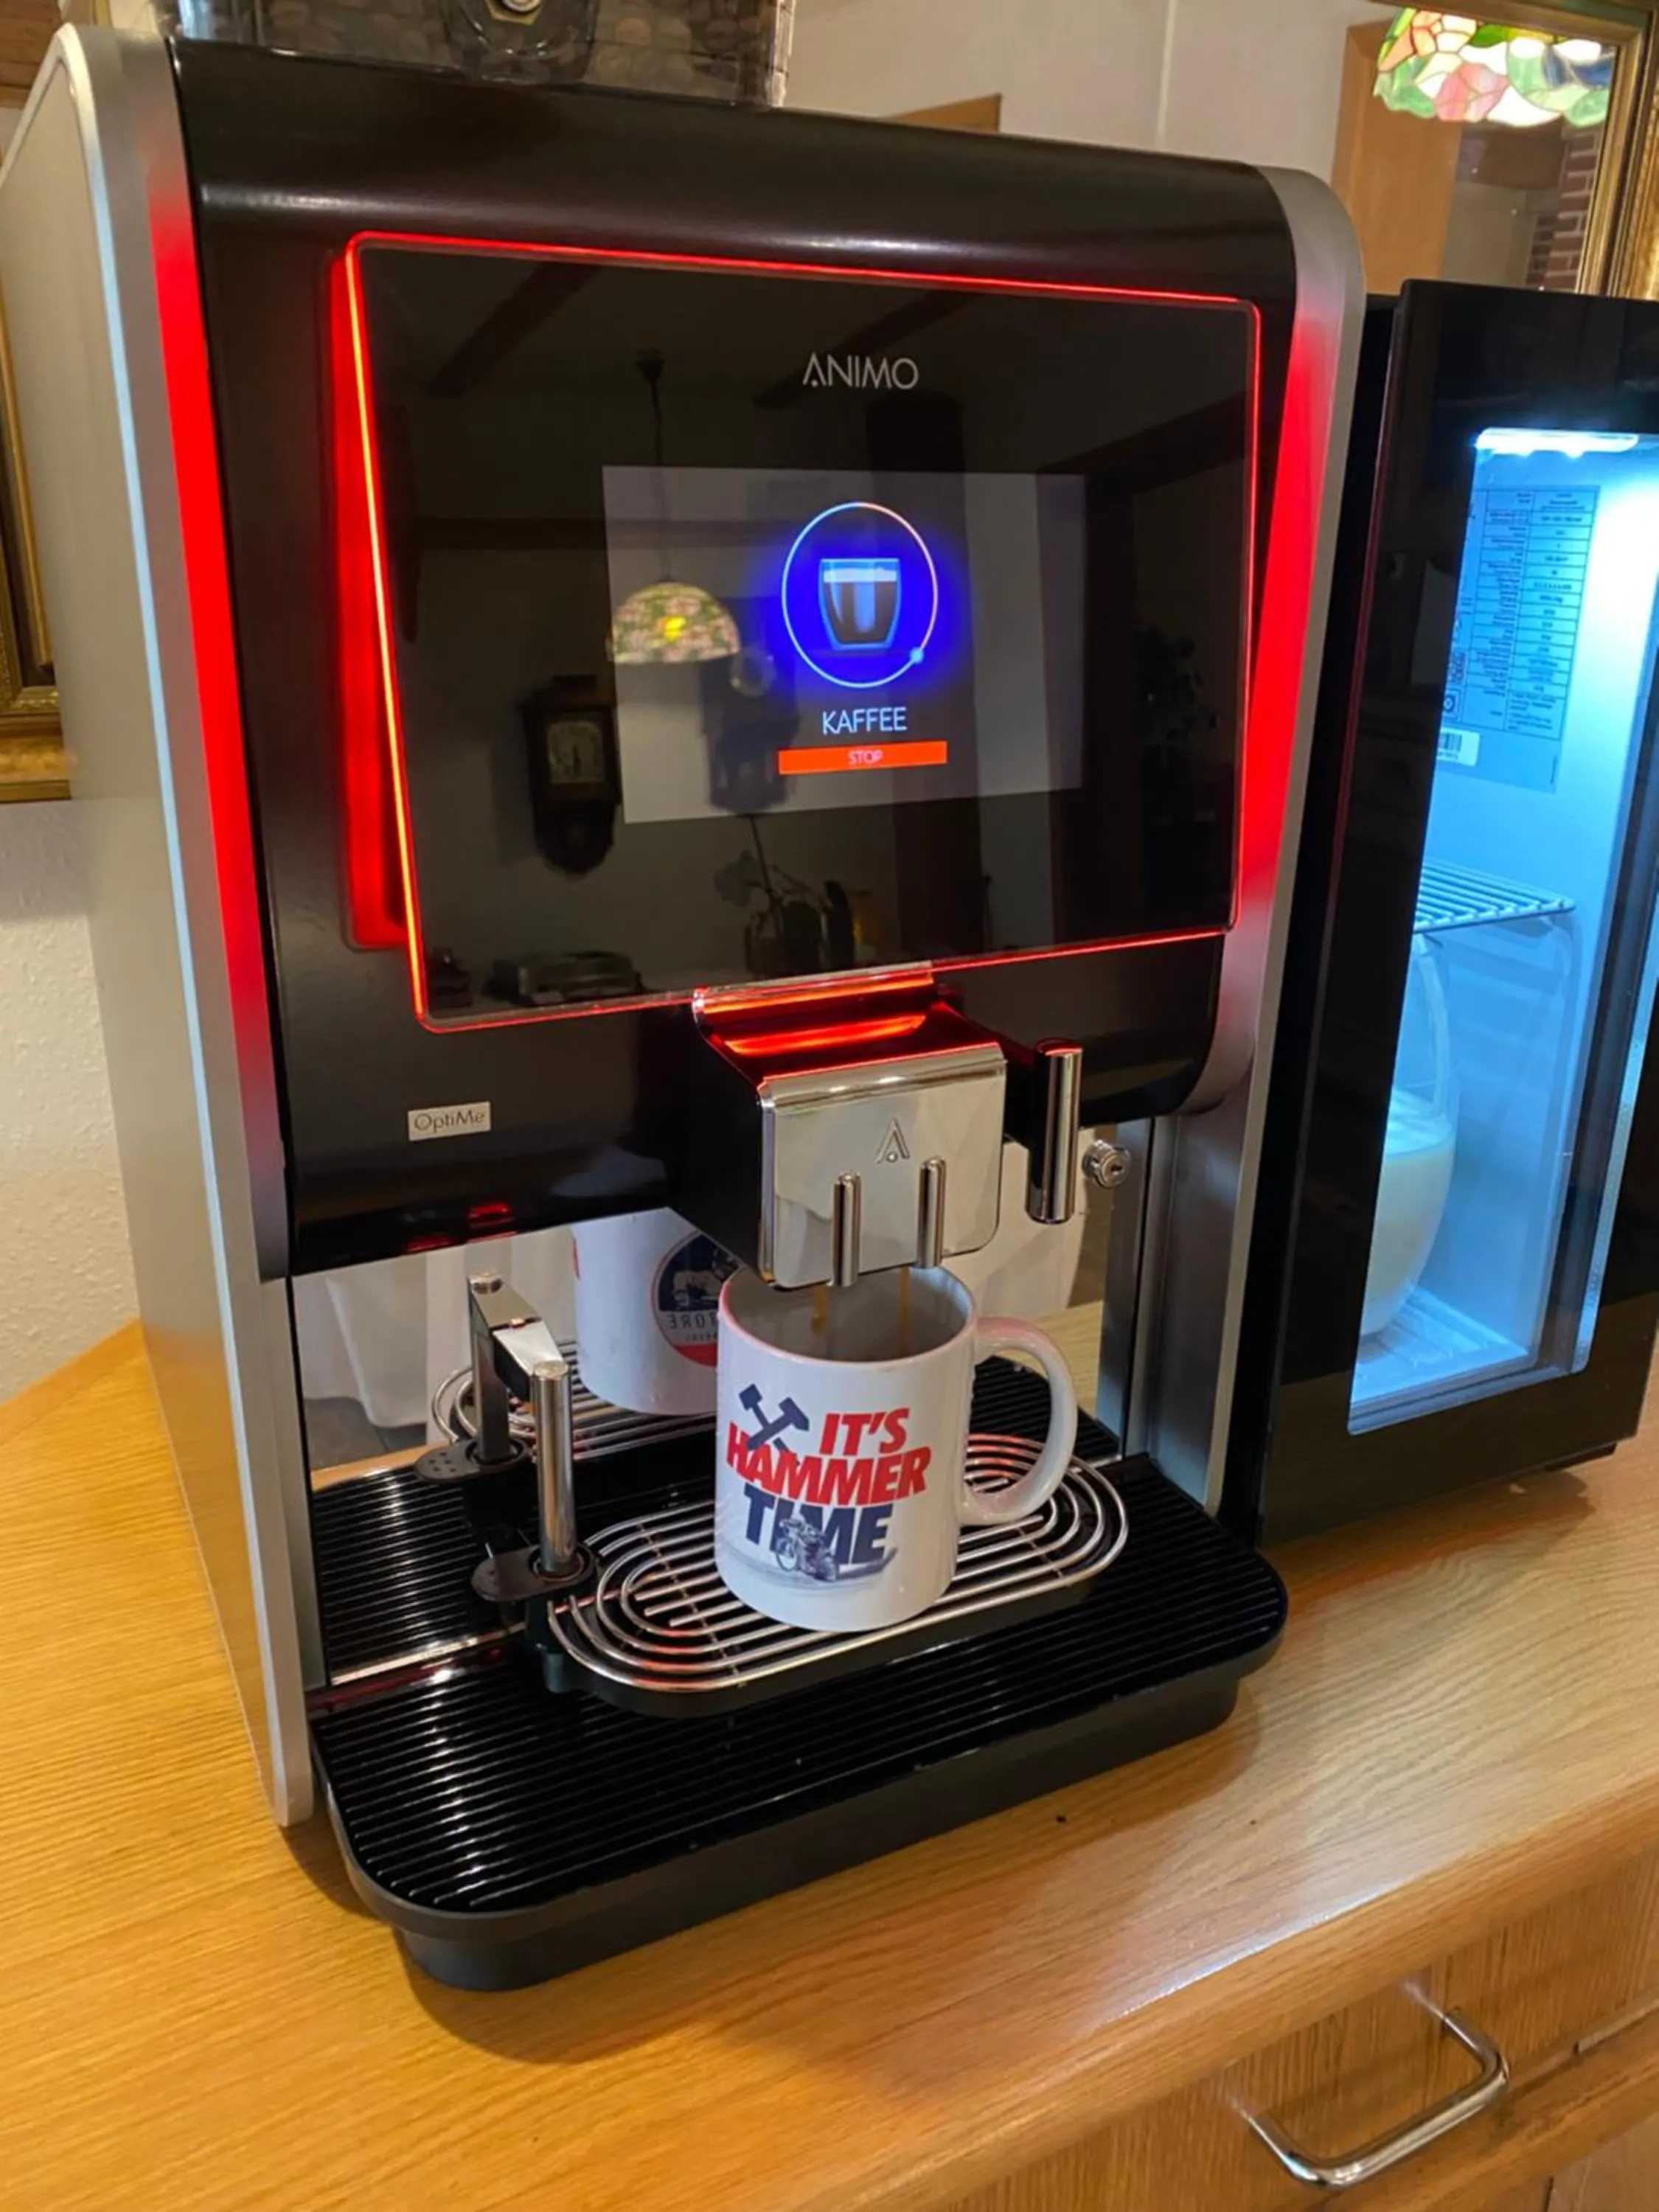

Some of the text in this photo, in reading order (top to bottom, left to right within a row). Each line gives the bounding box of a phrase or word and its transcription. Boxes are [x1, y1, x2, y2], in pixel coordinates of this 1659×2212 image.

[802, 352, 919, 389] ANIMO
[822, 706, 908, 735] KAFFEE
[849, 749, 883, 766] STOP
[414, 1109, 484, 1134] OptiMe
[819, 1408, 909, 1455] IT'S
[726, 1421, 932, 1507] HAMMER
[743, 1483, 894, 1565] TIME
